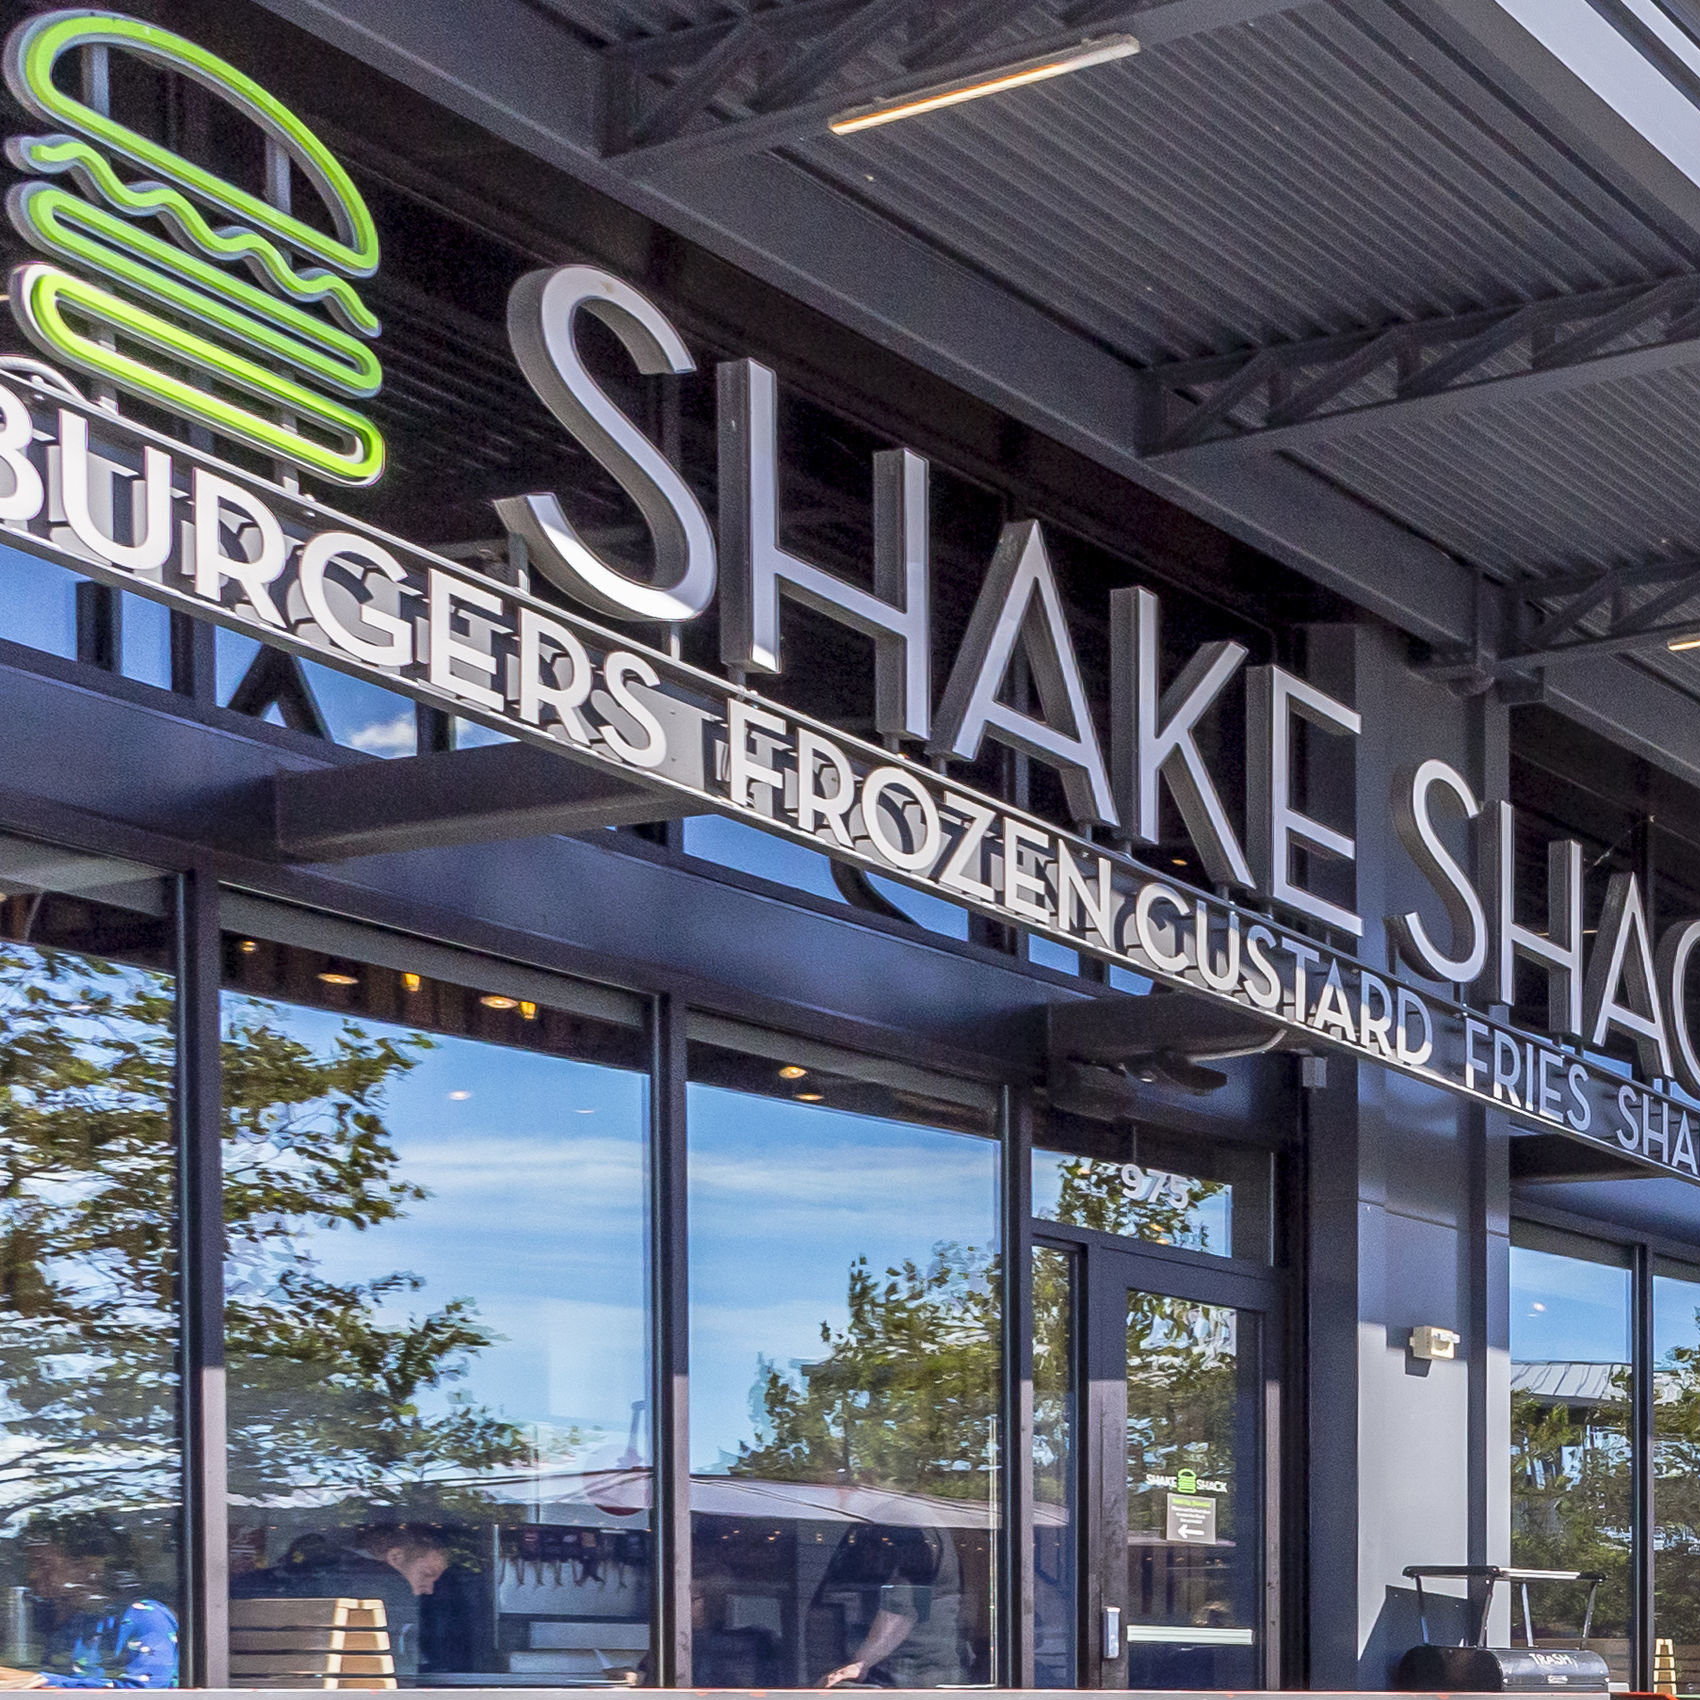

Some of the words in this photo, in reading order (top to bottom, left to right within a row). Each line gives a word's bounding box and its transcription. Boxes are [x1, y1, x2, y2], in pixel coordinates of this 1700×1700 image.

[497, 263, 1365, 938] SHAKE
[0, 384, 668, 771] BURGERS
[728, 697, 1112, 950] FROZEN
[1135, 881, 1434, 1067] CUSTARD
[1463, 1020, 1593, 1131] FRIES
[1121, 1163, 1189, 1209] 975
[1196, 1478, 1228, 1493] SHACK
[1528, 1652, 1574, 1666] TRASH
